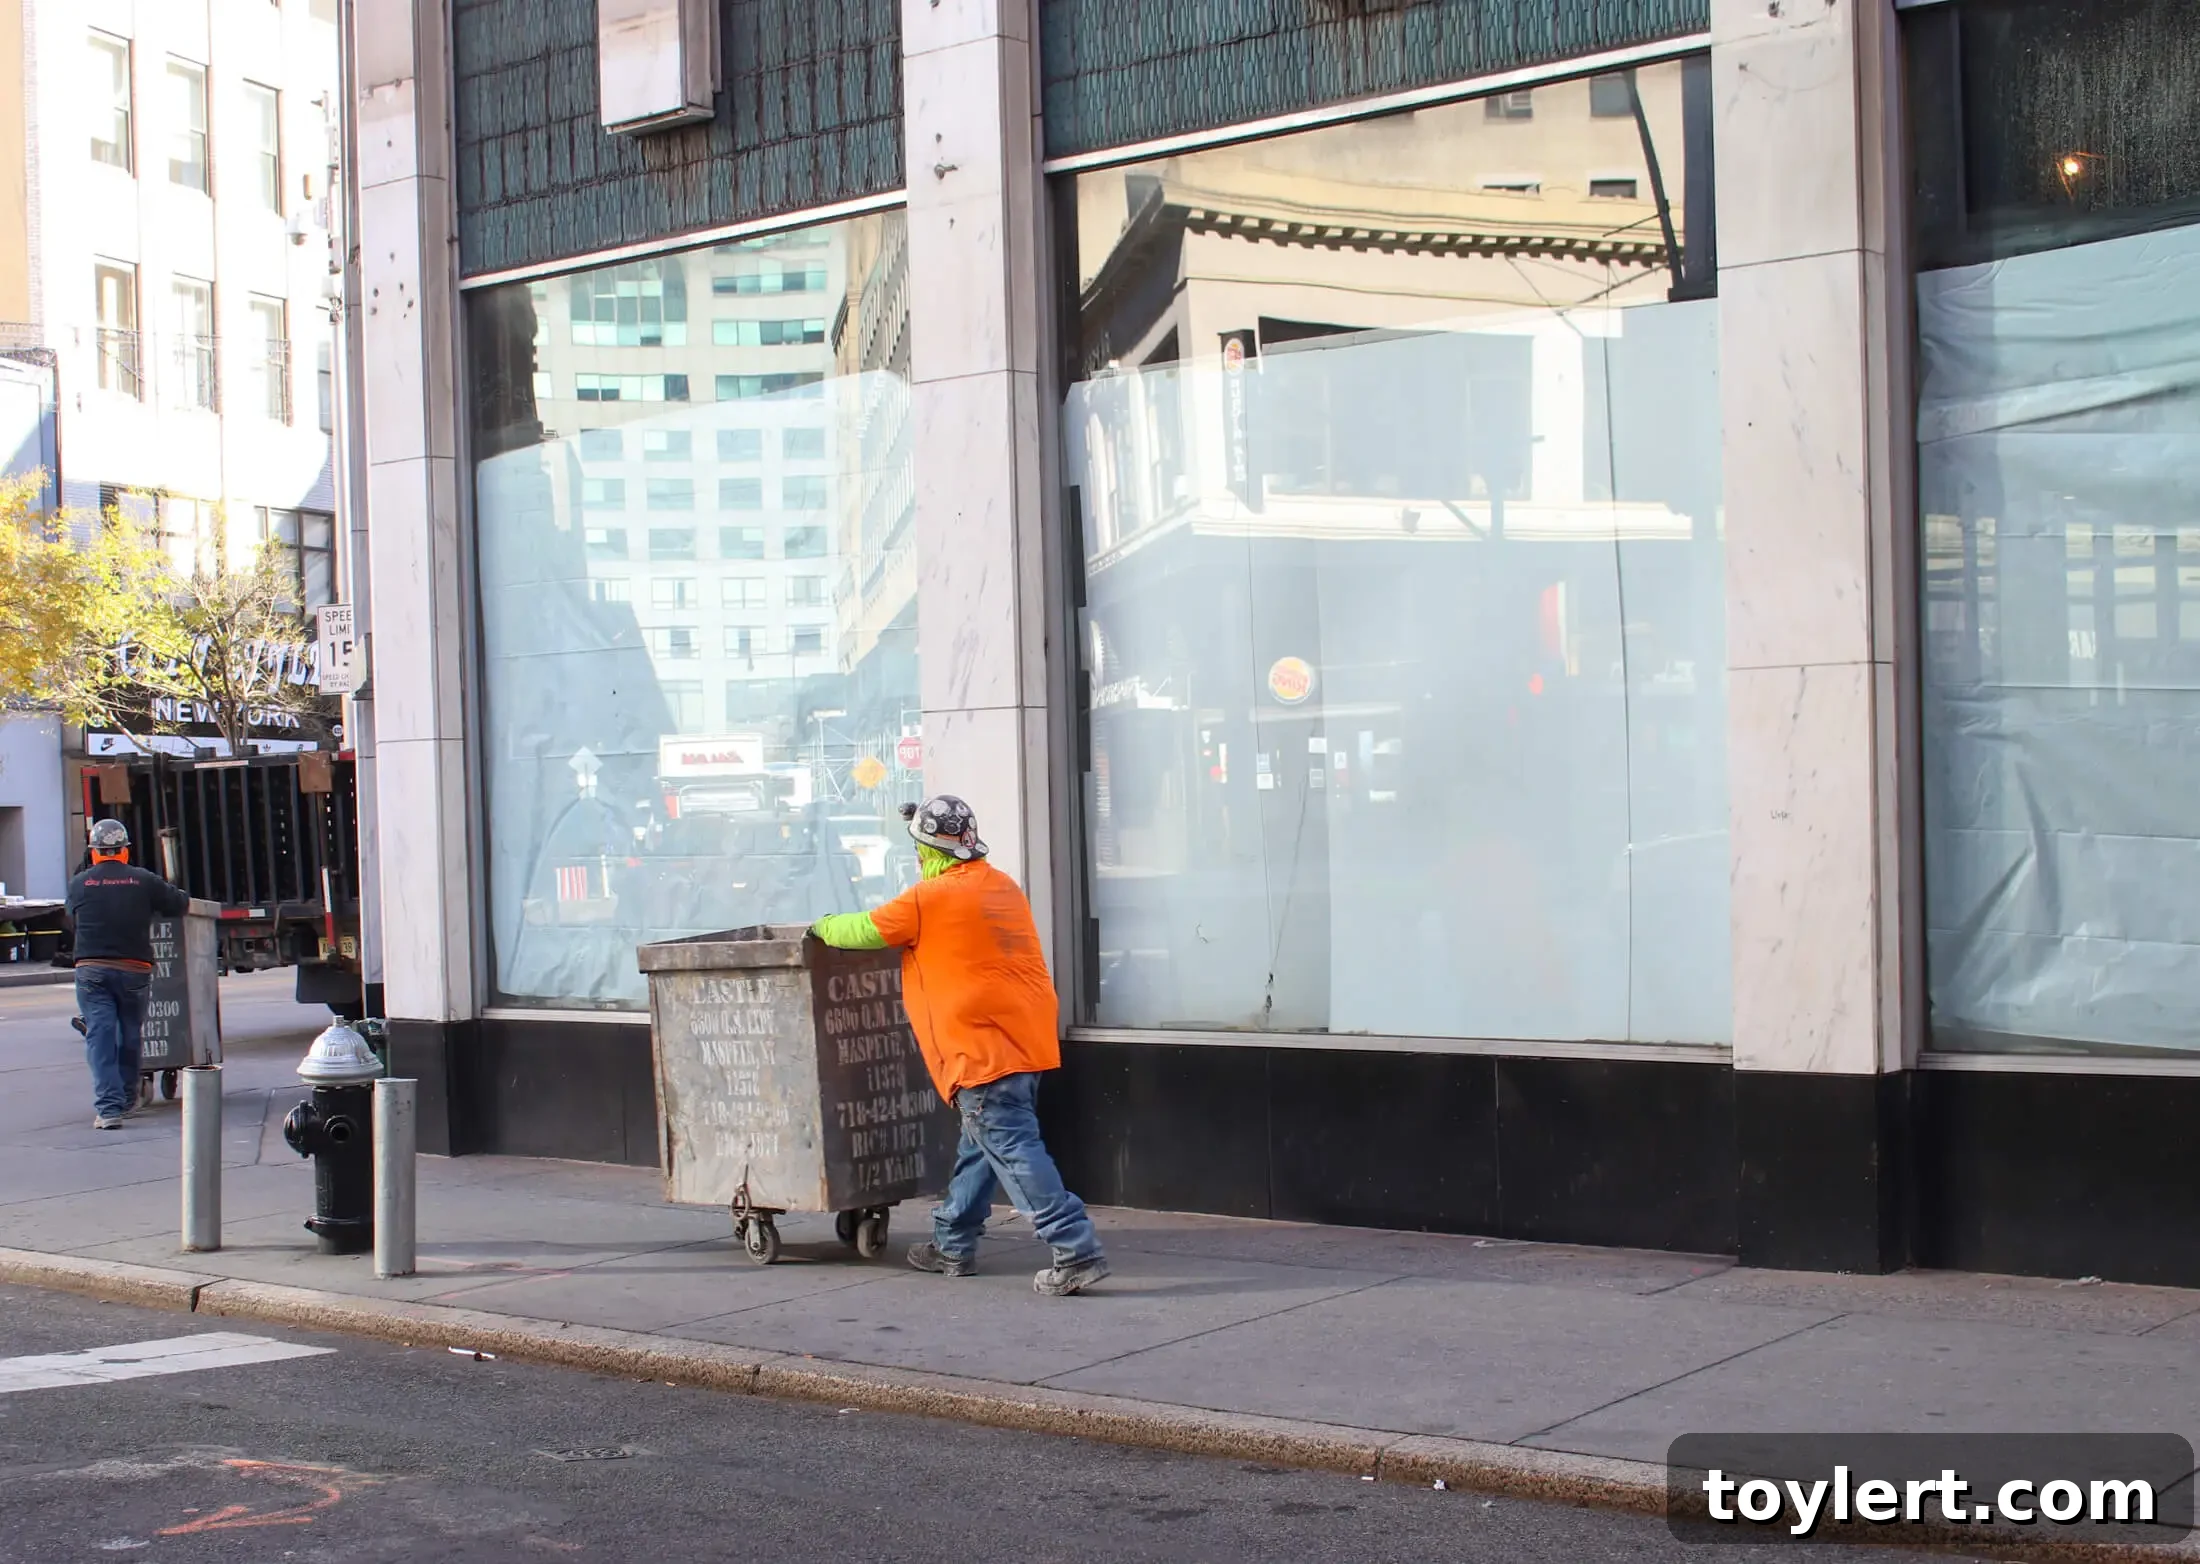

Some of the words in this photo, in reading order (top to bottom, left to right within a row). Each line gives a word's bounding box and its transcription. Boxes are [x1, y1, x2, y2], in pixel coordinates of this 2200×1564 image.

[325, 610, 352, 622] SPEE
[329, 640, 352, 667] 15
[151, 942, 178, 959] XPY.
[688, 977, 772, 1004] CASTLE
[828, 968, 903, 1003] CASTL
[148, 1001, 180, 1017] 0300
[141, 1040, 168, 1057] ARD
